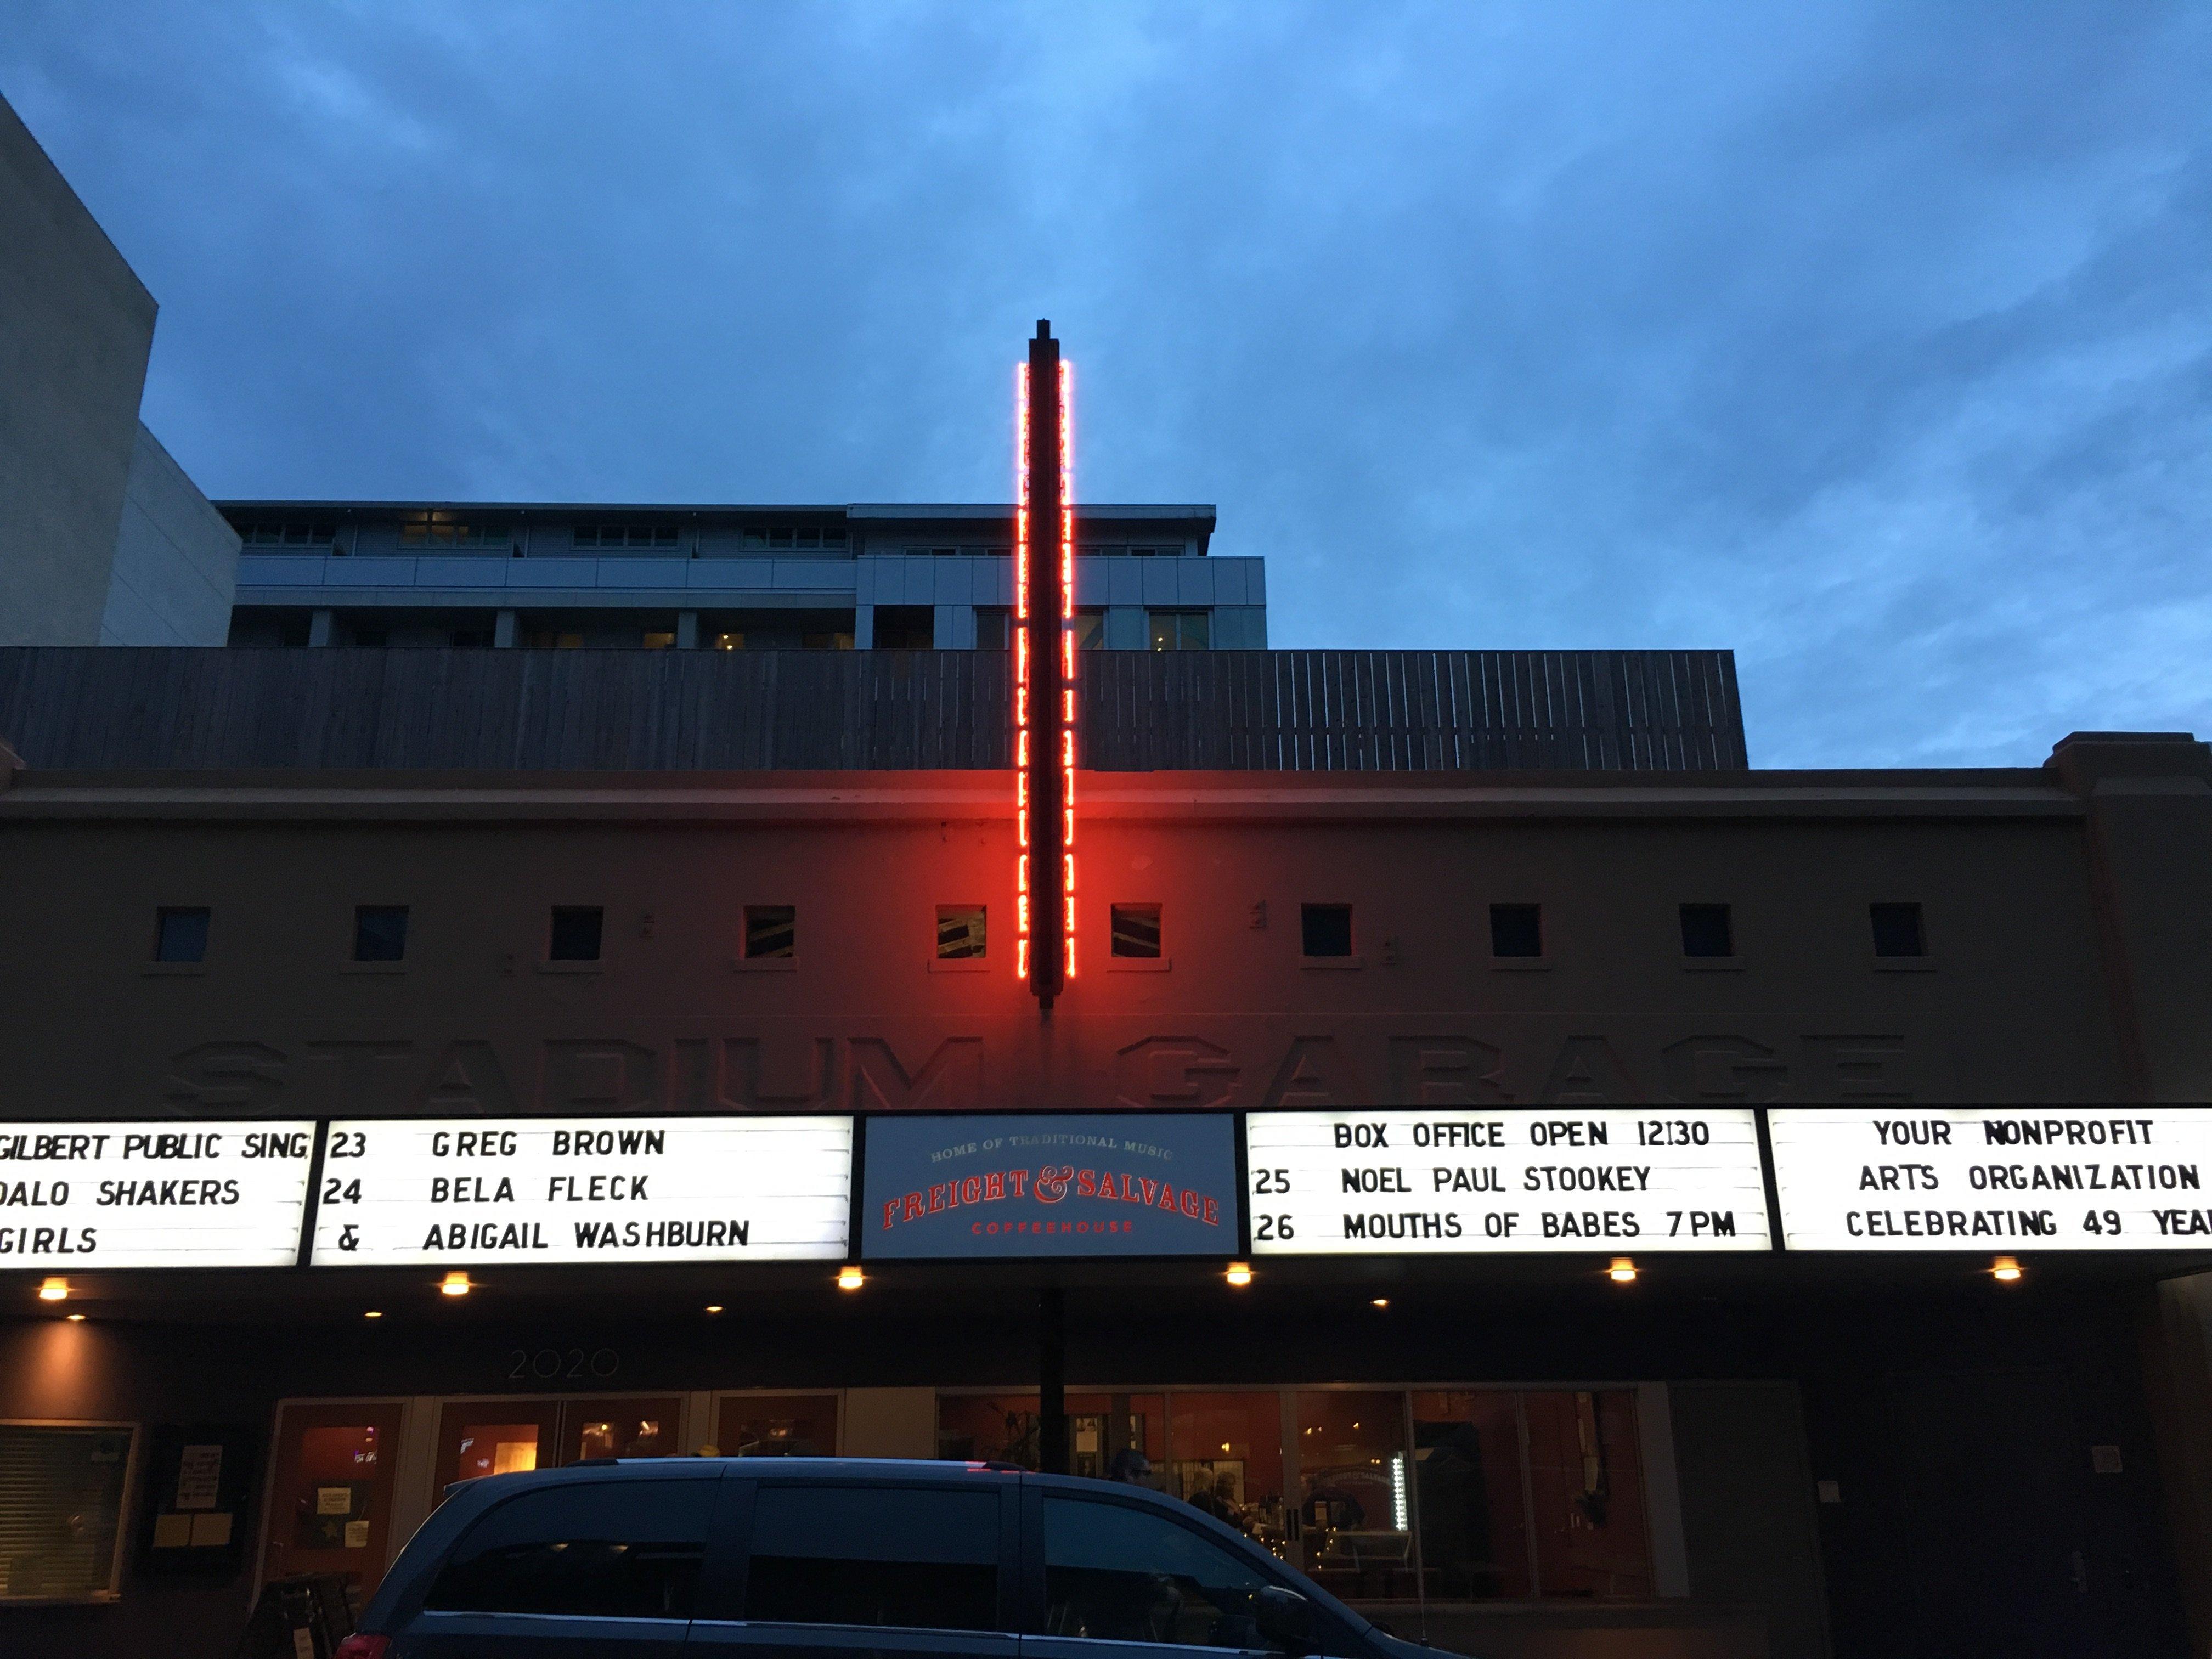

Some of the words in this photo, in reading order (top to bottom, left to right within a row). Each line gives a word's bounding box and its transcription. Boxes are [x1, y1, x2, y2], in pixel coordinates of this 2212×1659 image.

[165, 1036, 986, 1116] STADIUM
[1114, 1034, 1916, 1109] GARAGE
[123, 1134, 222, 1159] PUBLIC
[242, 1133, 308, 1158] SING
[331, 1132, 365, 1158] 23
[433, 1131, 517, 1156] GREG
[553, 1130, 664, 1155] BROWN
[1334, 1124, 1388, 1148] BOX
[1413, 1122, 1505, 1147] OFFICE
[1531, 1121, 1607, 1146] OPEN
[1873, 1121, 1951, 1145] YOUR
[1983, 1120, 2153, 1145] NONPROFIT
[931, 1143, 977, 1163] HOME
[983, 1138, 1003, 1150] OF
[1009, 1133, 1117, 1148] TRADITIONAL
[1125, 1140, 1173, 1160] MUSIC
[323, 1178, 361, 1204] 24
[431, 1177, 514, 1202] BELA
[548, 1176, 648, 1201] FLECK
[1256, 1169, 1290, 1194] 25
[1342, 1168, 1411, 1193] NOEL
[1434, 1167, 1505, 1192] PAUL
[1524, 1167, 1650, 1191] STOOKEY
[1860, 1165, 1938, 1190] ARTS
[1970, 1165, 2200, 1189] ORGANIZATION
[97, 1180, 239, 1205] SHAKERS
[883, 1169, 1029, 1230] FREIGHT
[1034, 1165, 1074, 1203] &
[1078, 1169, 1219, 1227] SALVAGE
[339, 1225, 359, 1251] &
[423, 1223, 548, 1250] ABIGAIL
[575, 1221, 749, 1248] WASHBURN
[972, 1220, 1132, 1234] COFFEEHOUSE
[1255, 1215, 1294, 1240] 26
[1344, 1213, 1462, 1239] MOUTHS
[1485, 1213, 1519, 1237] OF
[1542, 1212, 1639, 1237] BABES
[1847, 1210, 2056, 1236] CELEBRATING
[2083, 1210, 2121, 1235] 49
[2152, 1210, 2212, 1235] YEA
[0, 1228, 96, 1253] GIRLS
[508, 1348, 619, 1379] 2020
